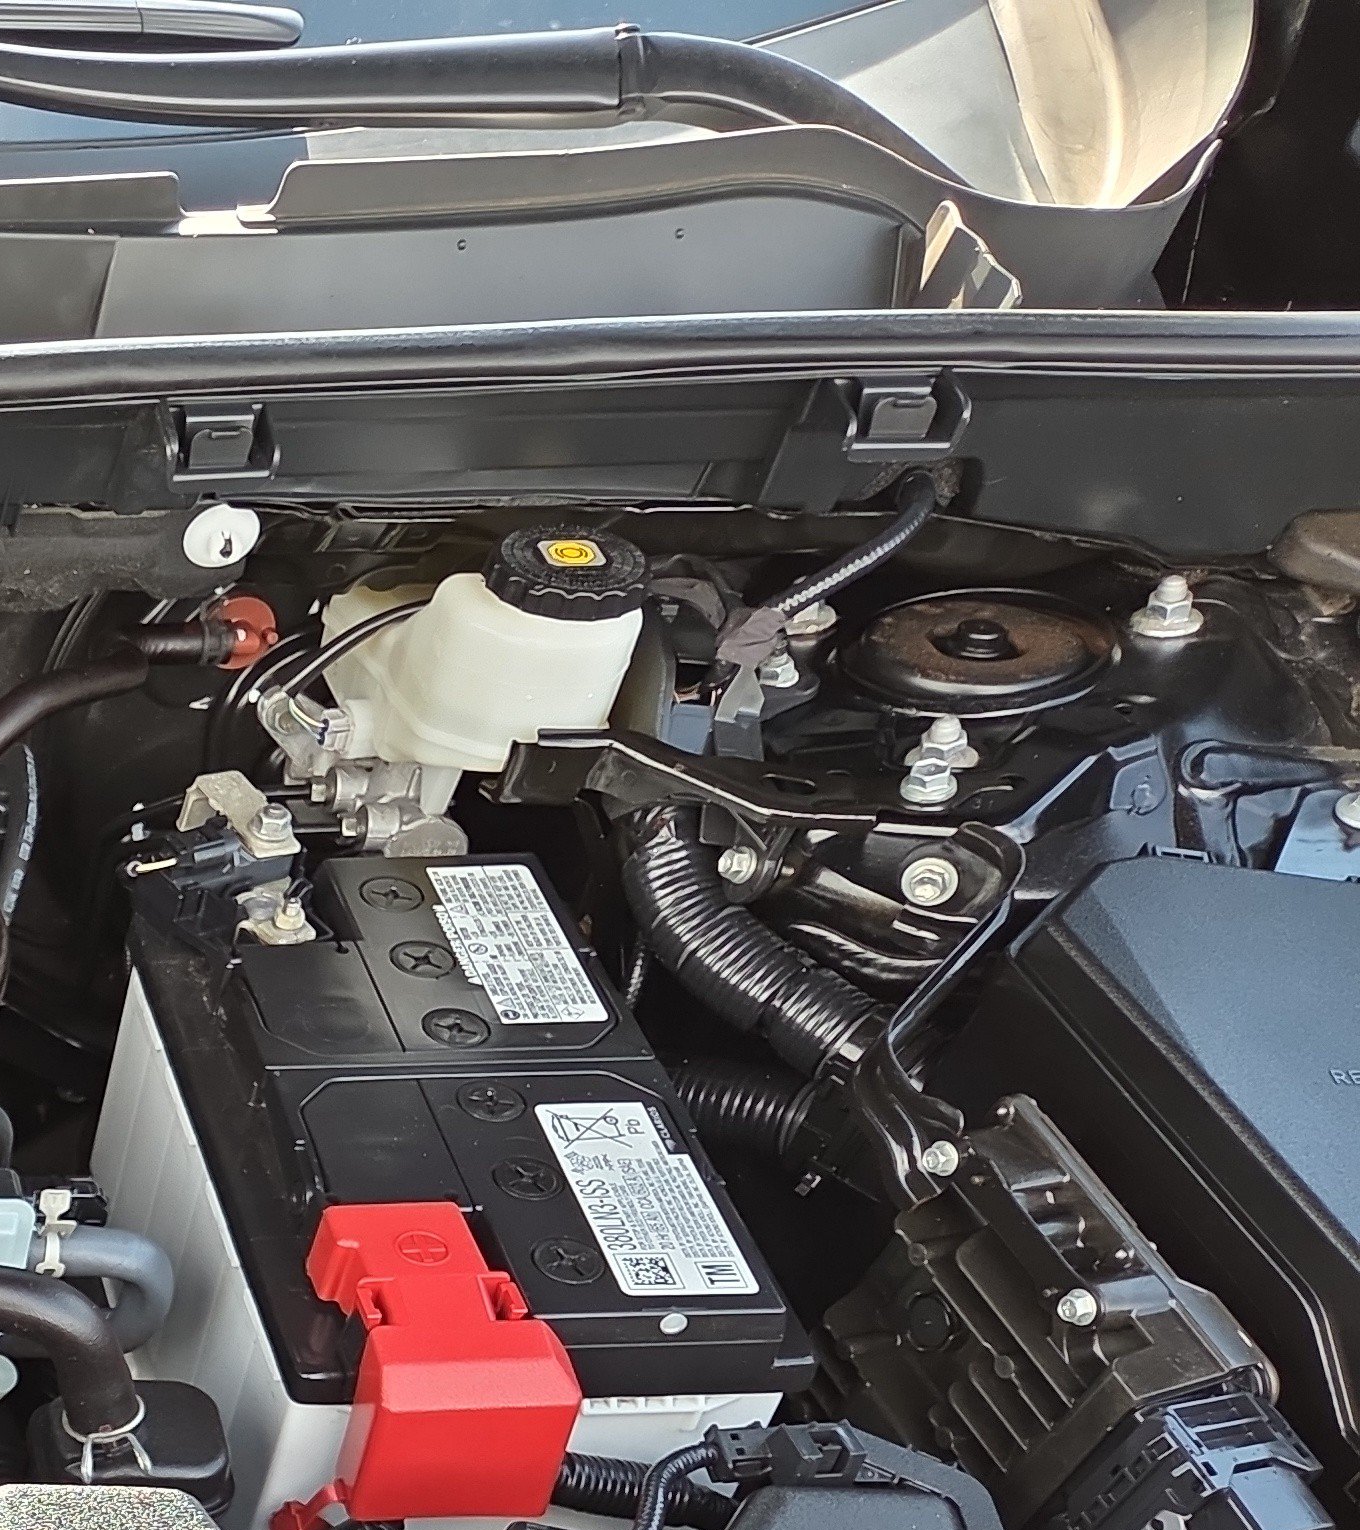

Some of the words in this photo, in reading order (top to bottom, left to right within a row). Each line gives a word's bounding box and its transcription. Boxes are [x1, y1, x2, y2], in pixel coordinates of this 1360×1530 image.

[623, 1118, 645, 1135] Pb
[575, 1179, 637, 1251] 380LN3-ISS
[701, 1263, 741, 1285] TM
